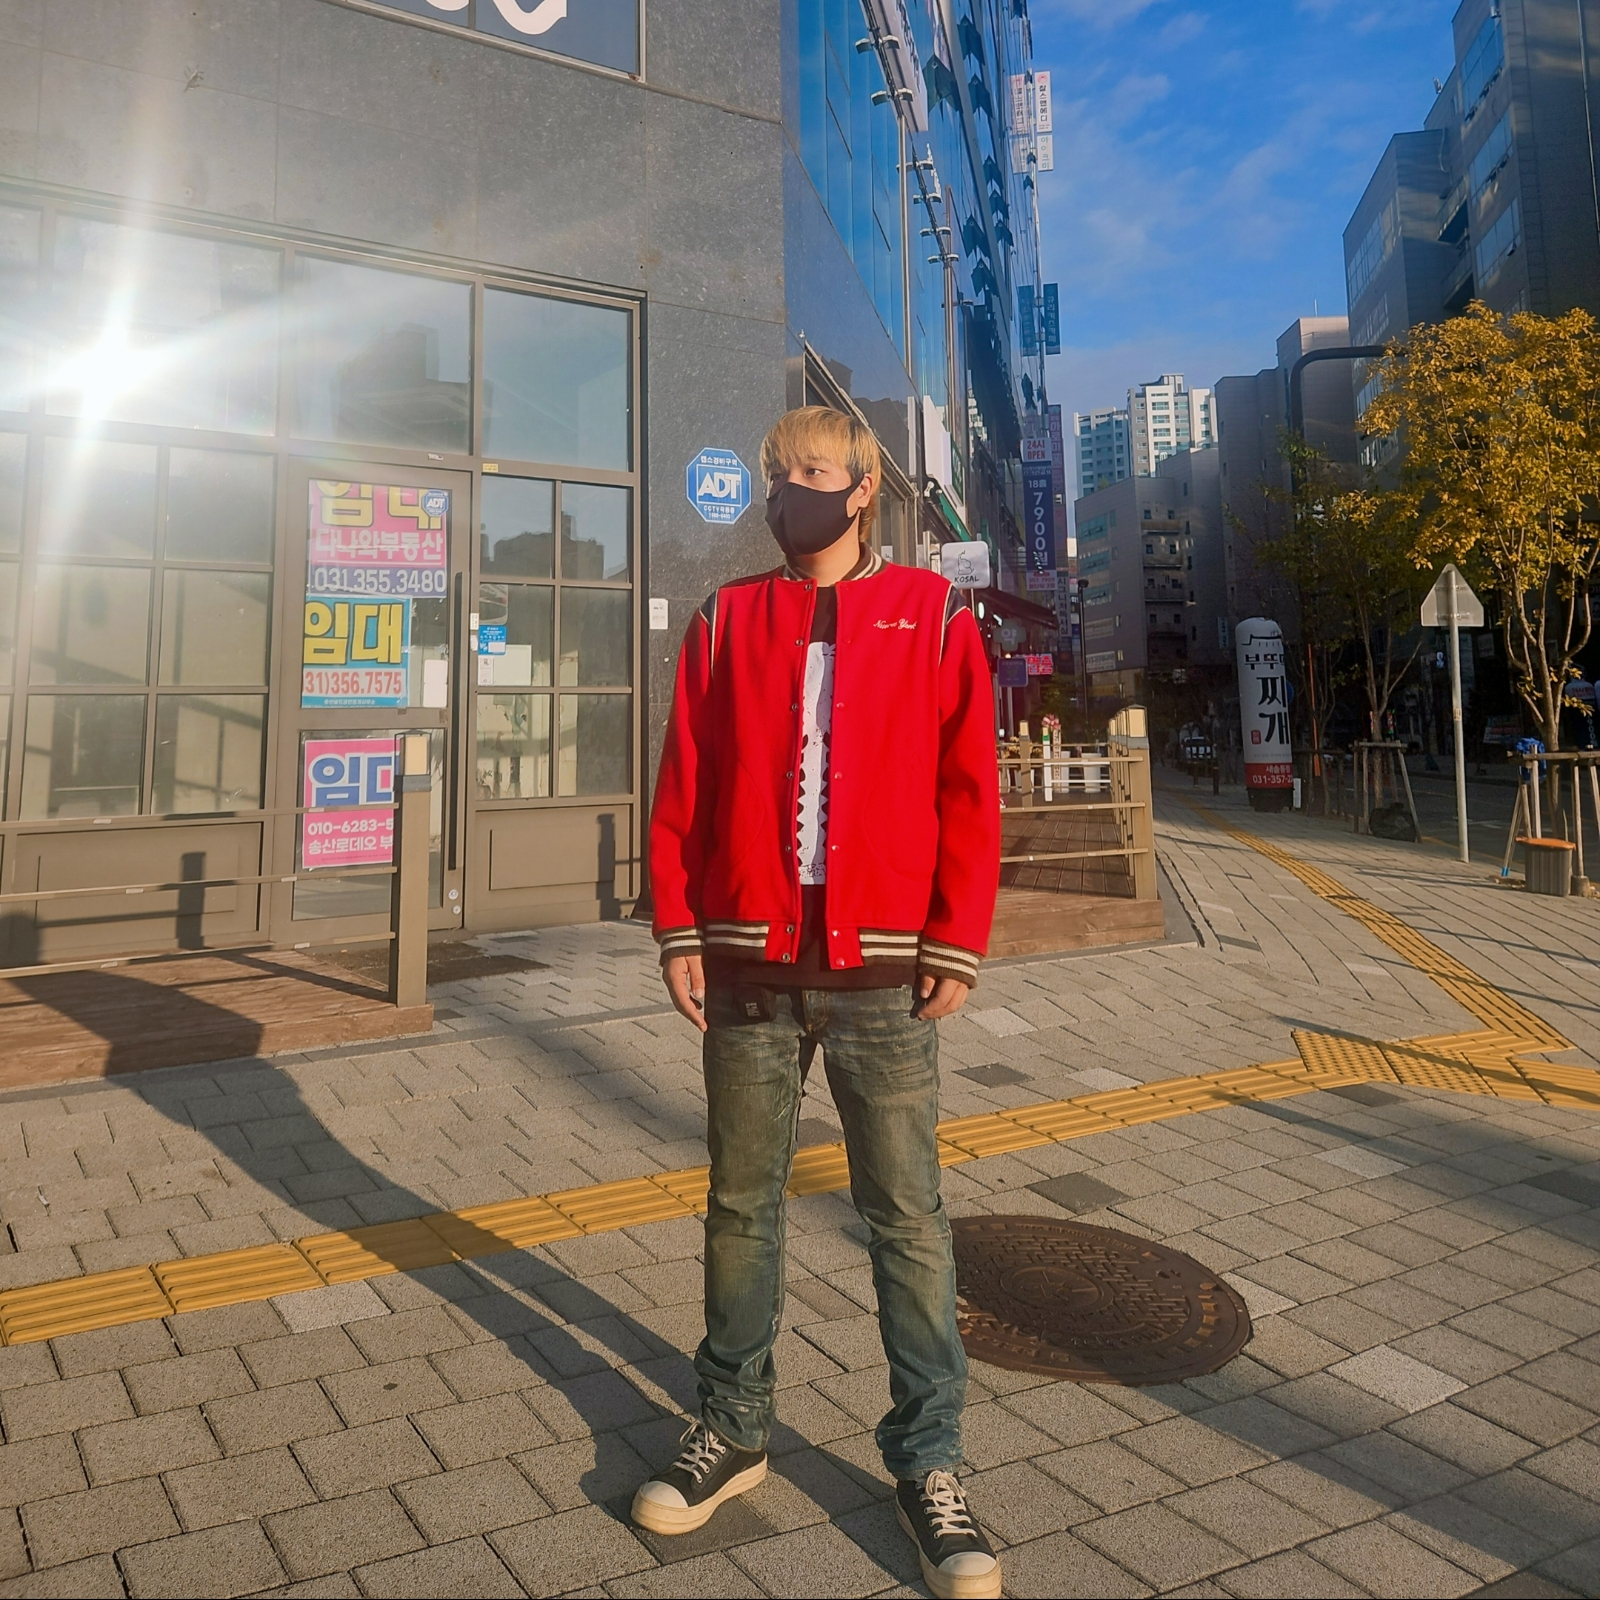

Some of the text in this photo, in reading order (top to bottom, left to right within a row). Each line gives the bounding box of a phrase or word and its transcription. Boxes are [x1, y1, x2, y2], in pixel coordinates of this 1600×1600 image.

[1027, 439, 1046, 450] 24시
[1027, 450, 1046, 460] OPEN
[698, 471, 742, 500] ADT
[426, 497, 446, 509] ADT
[315, 528, 444, 562] 다나와부동산
[954, 575, 980, 584] KOSAL
[897, 617, 918, 630] York
[303, 600, 404, 665] 임대
[1000, 628, 1018, 645] 약
[1256, 675, 1290, 745] 찌개
[307, 836, 377, 855] 송산로데오
